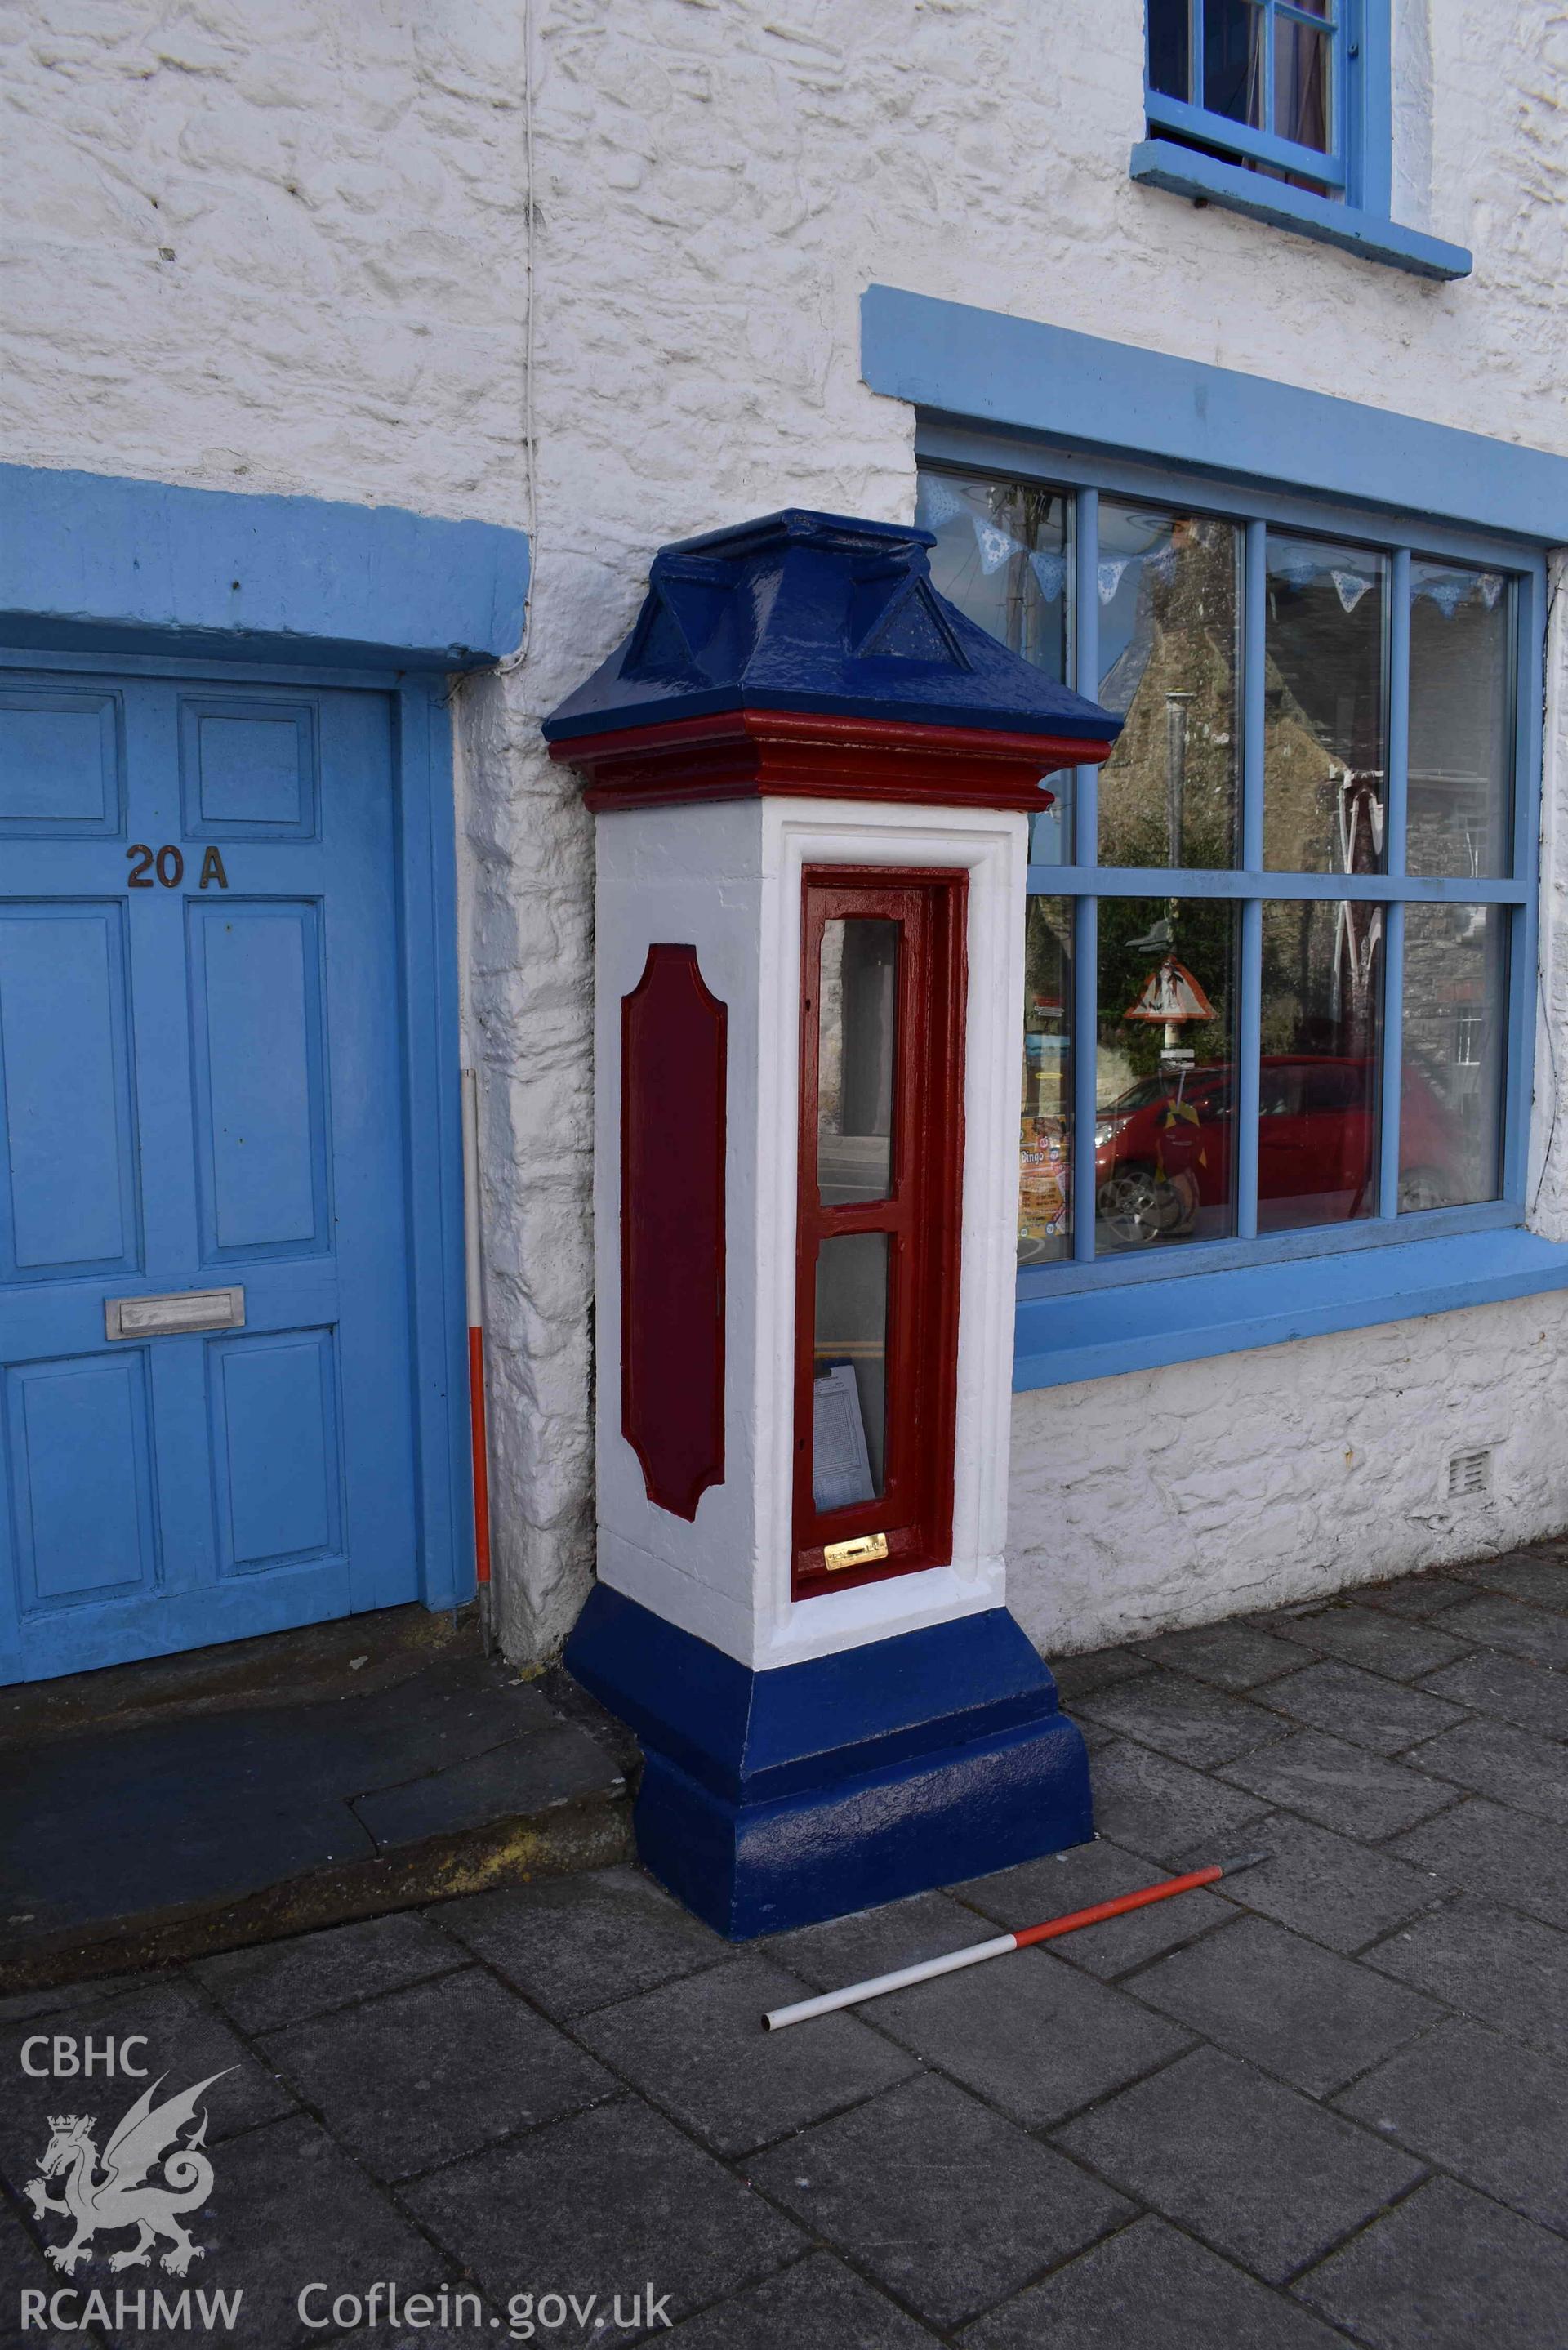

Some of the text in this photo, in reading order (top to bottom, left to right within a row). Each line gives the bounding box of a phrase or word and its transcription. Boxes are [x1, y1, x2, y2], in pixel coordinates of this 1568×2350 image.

[126, 844, 229, 889] 20 A
[1021, 1150, 1045, 1166] Bingo
